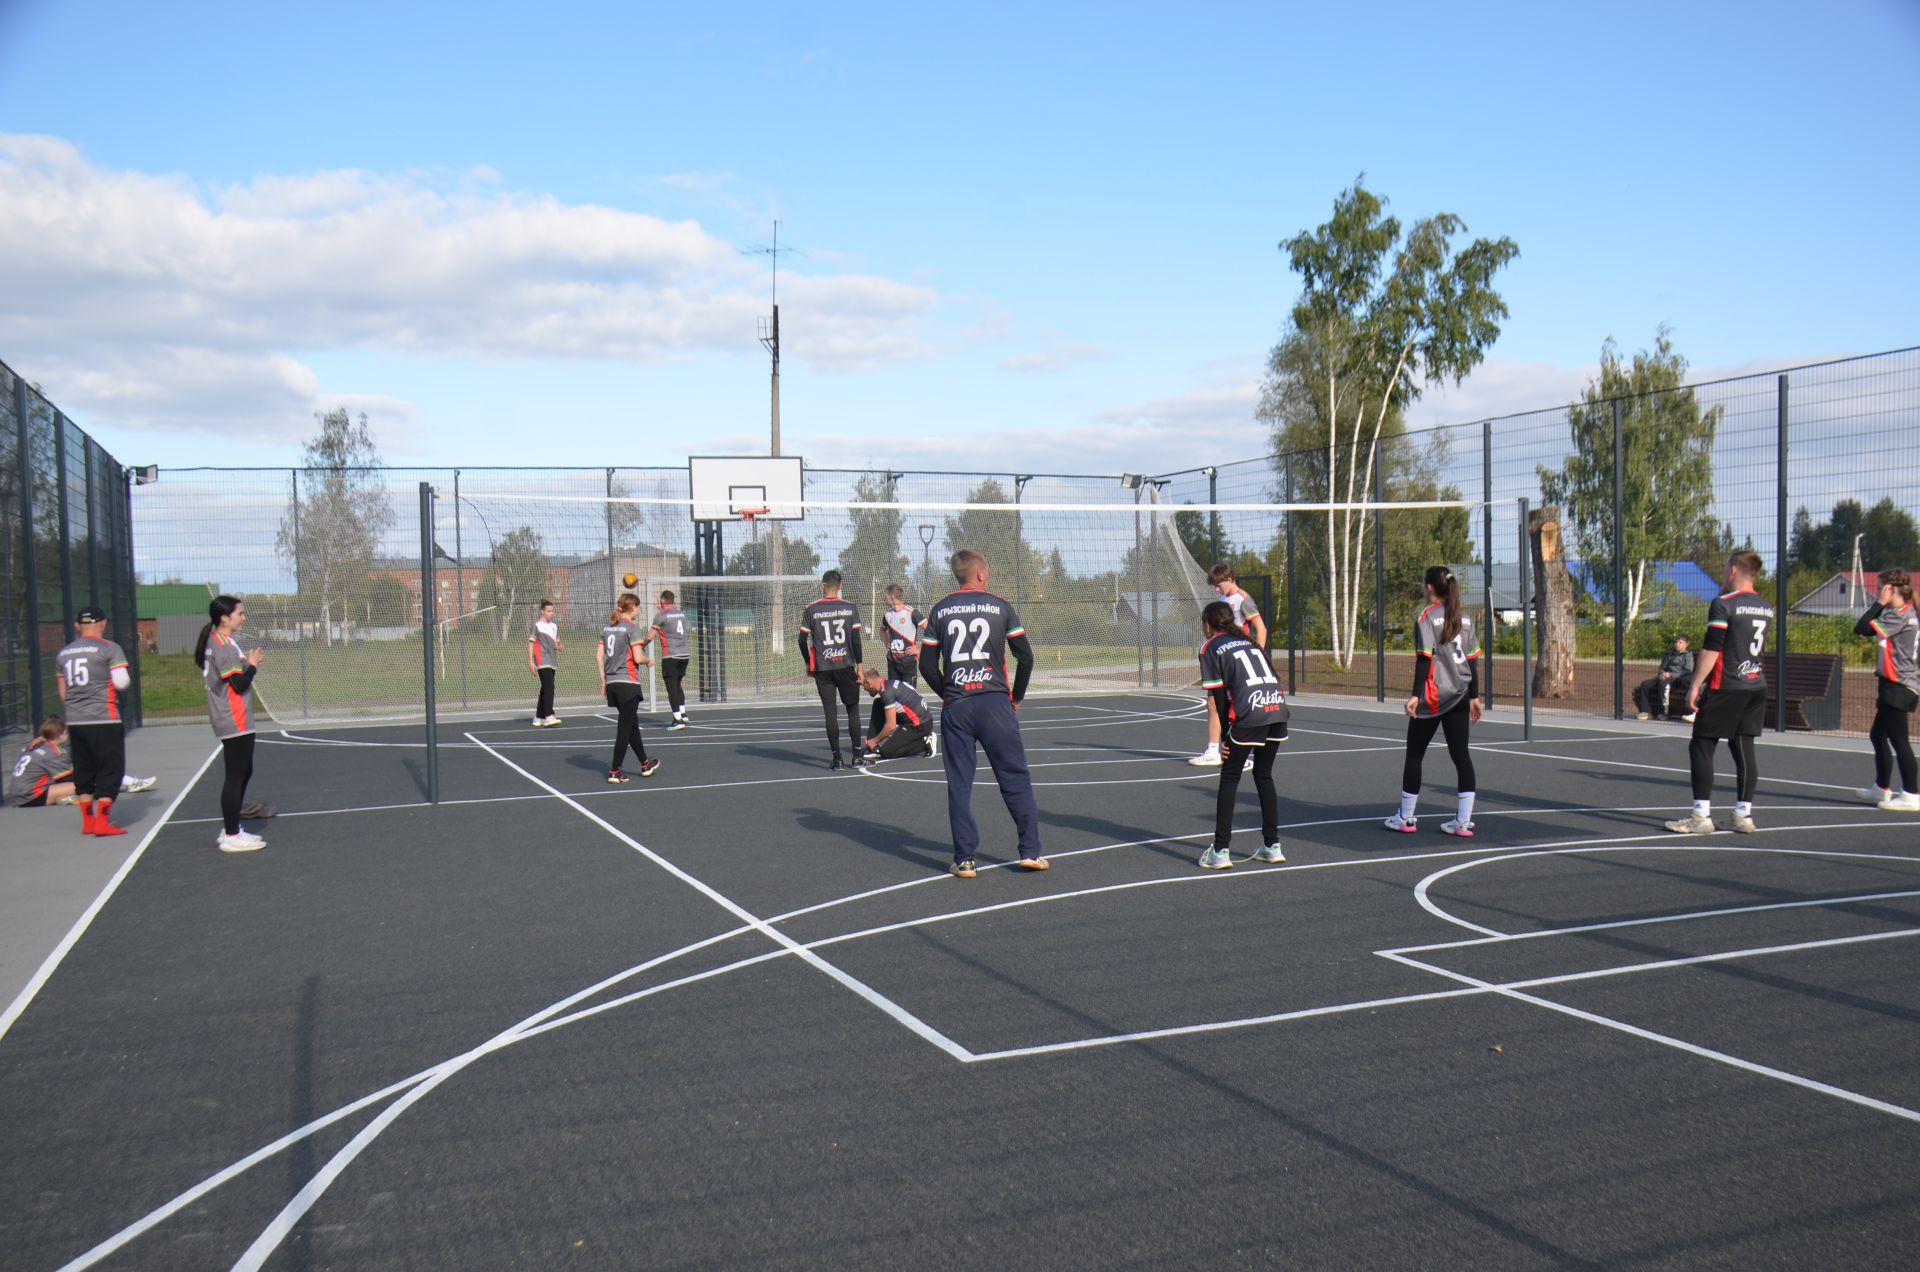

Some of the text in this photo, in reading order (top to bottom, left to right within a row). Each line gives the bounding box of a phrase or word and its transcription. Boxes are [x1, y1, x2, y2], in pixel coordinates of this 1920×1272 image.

[938, 604, 1000, 619] АГРЫЗСКИЙ РАЙОН
[676, 619, 684, 636] 4
[820, 618, 846, 646] 13
[948, 617, 990, 663] 22
[1749, 619, 1767, 656] 3
[606, 634, 616, 657] 9
[65, 657, 89, 687] 15
[952, 666, 992, 688] Raketa
[1232, 648, 1278, 687] 11
[1248, 689, 1284, 711] Raketa
